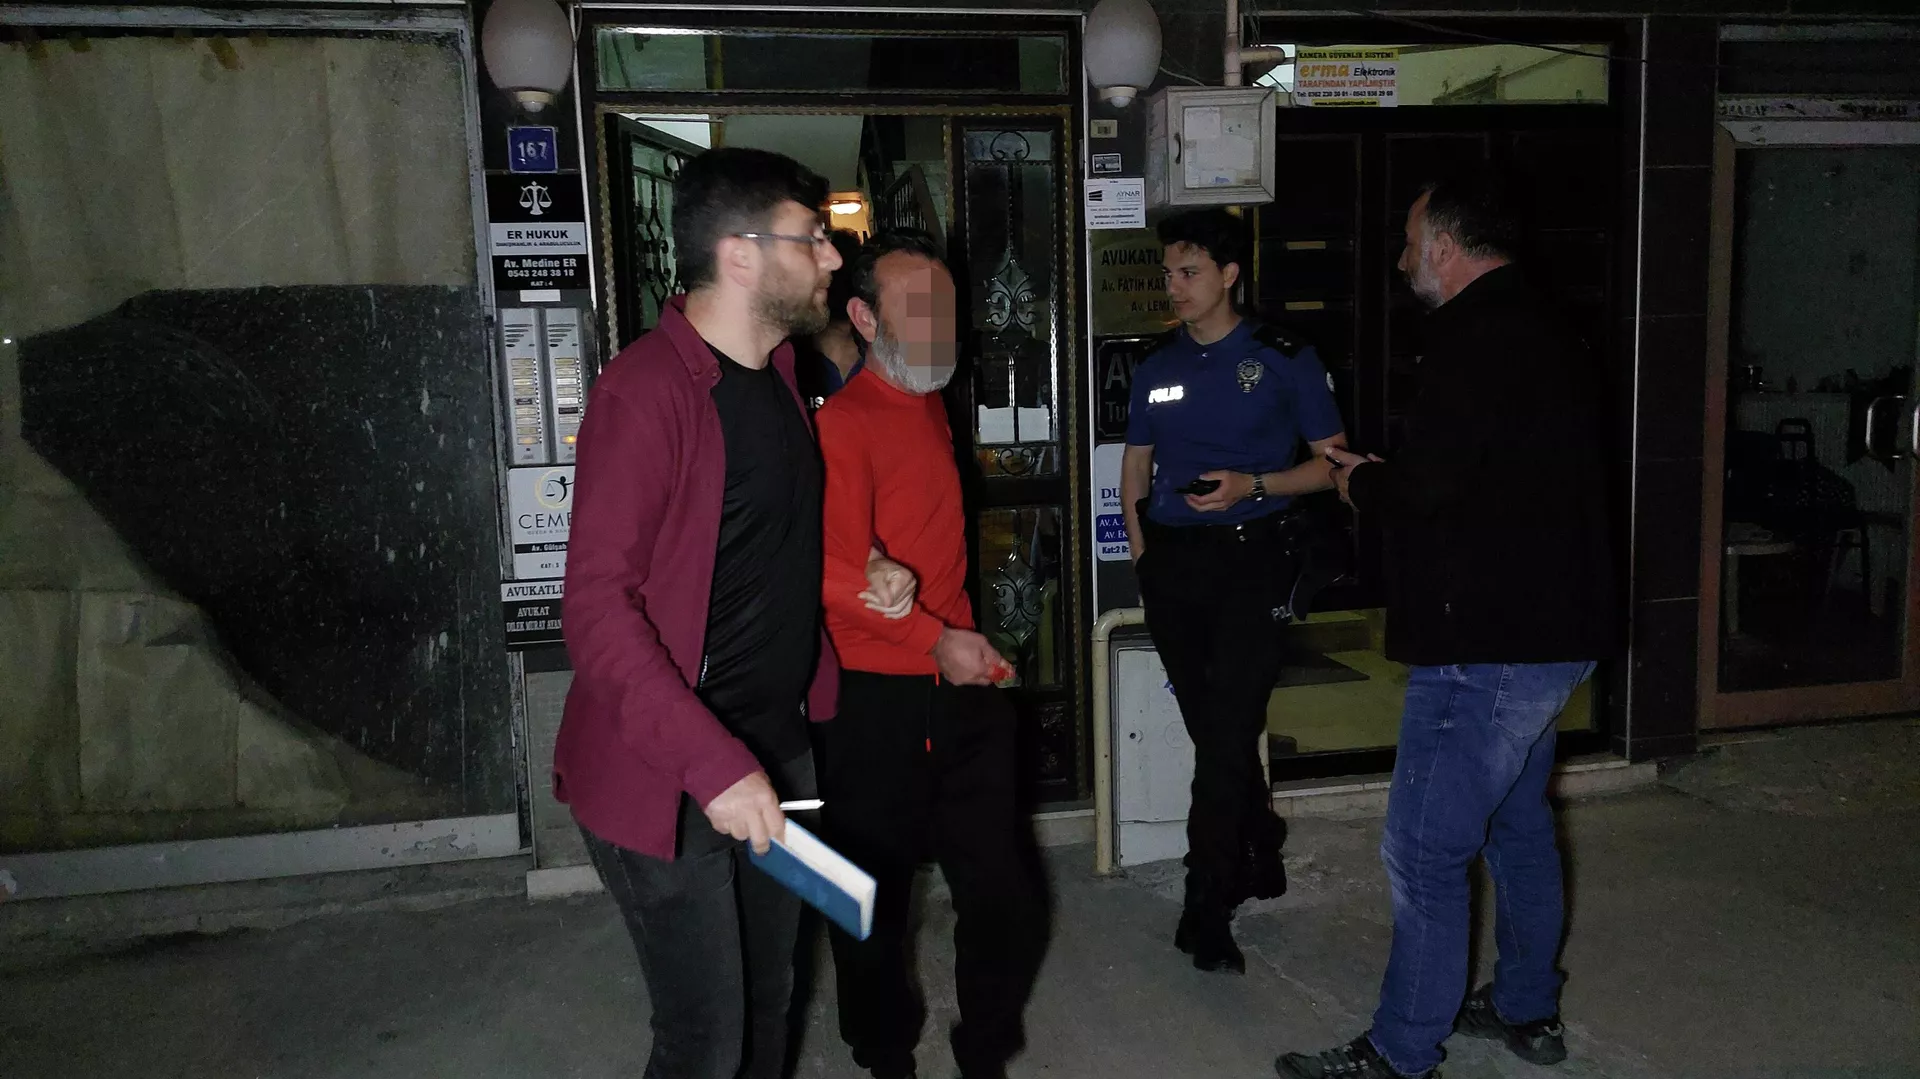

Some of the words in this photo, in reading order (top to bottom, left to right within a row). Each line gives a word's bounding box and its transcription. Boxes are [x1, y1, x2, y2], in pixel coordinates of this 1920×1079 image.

[1300, 64, 1350, 78] erma
[1353, 66, 1396, 77] Elektronik
[518, 142, 548, 158] 167
[1116, 190, 1140, 198] AYNAR
[507, 231, 522, 239] ER
[526, 230, 569, 239] HUKUK
[504, 259, 519, 268] Av.
[522, 259, 560, 268] Medine
[563, 258, 577, 267] ER
[508, 270, 530, 278] 0543
[1102, 279, 1115, 292] Av.
[517, 606, 550, 618] AVUKAT
